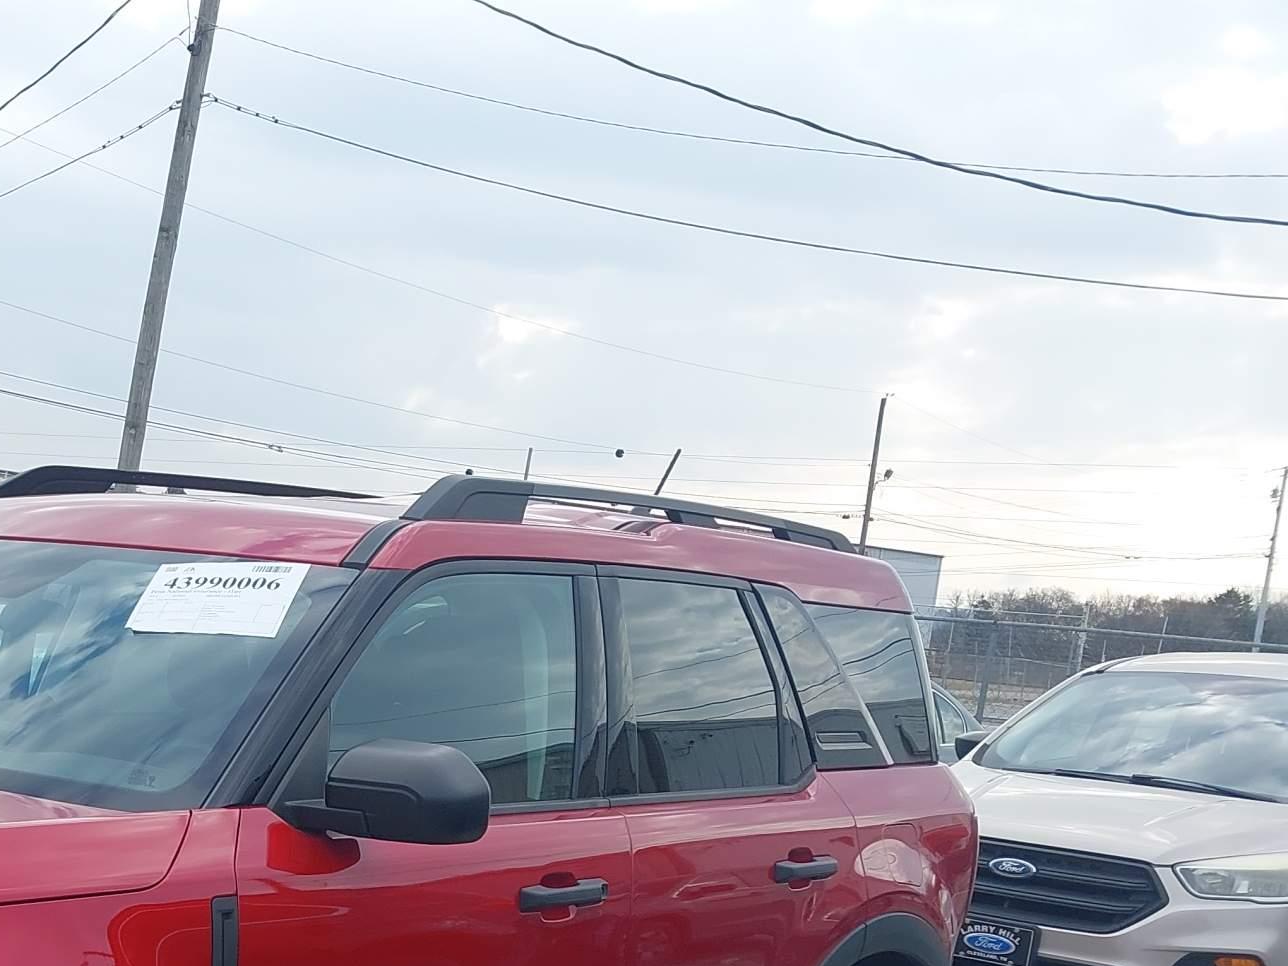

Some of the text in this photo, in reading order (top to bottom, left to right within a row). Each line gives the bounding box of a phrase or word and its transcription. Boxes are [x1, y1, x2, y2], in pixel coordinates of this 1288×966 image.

[164, 576, 283, 590] 43990006
[960, 924, 1022, 946] LARRY HILL
[974, 936, 1003, 951] Ford
